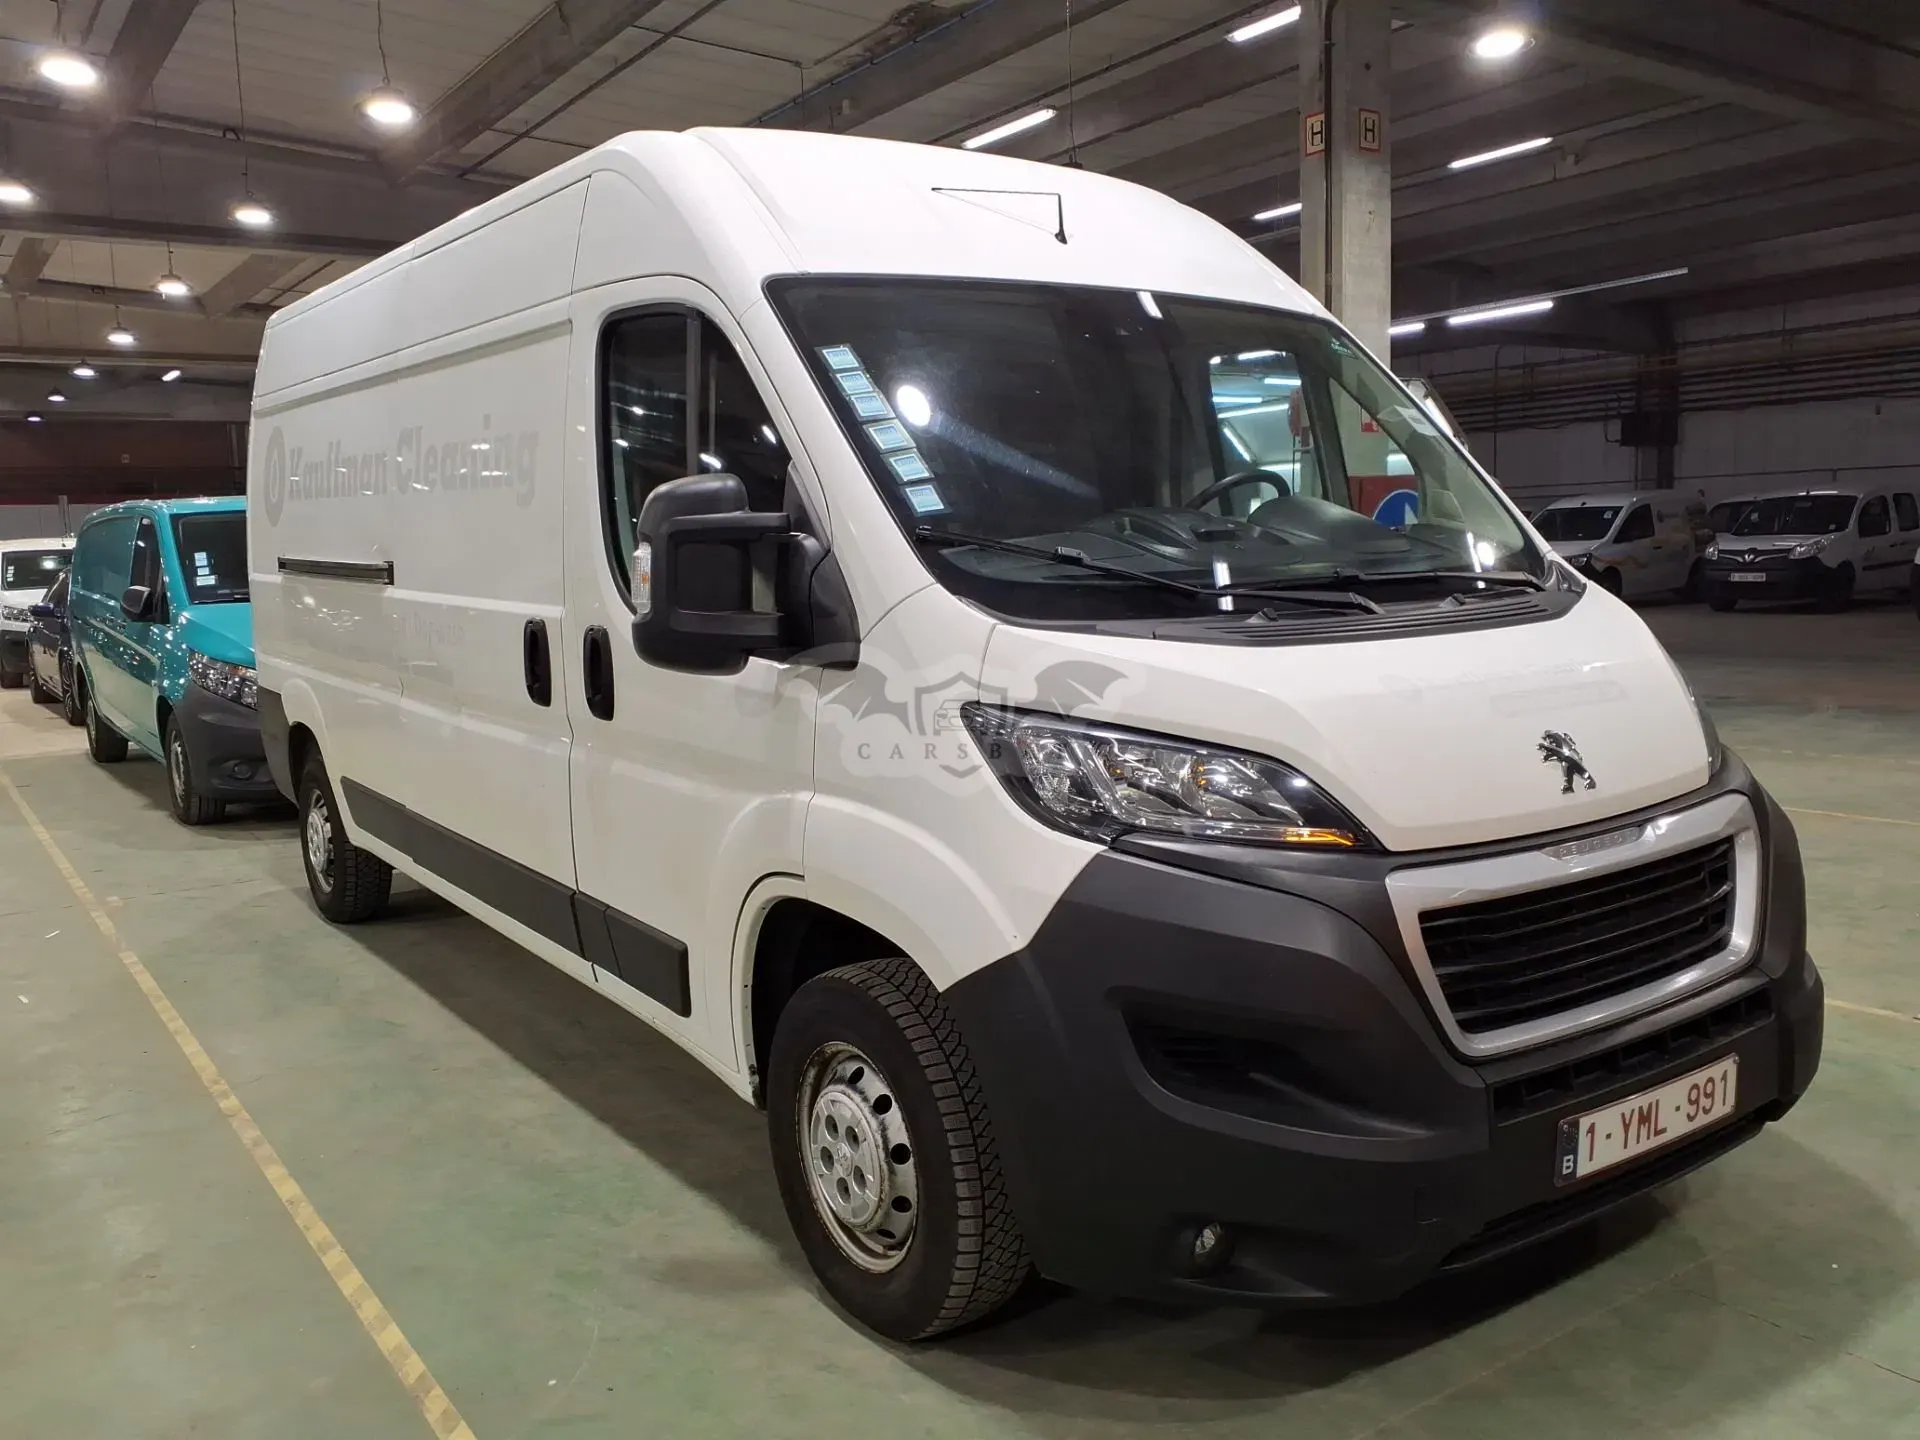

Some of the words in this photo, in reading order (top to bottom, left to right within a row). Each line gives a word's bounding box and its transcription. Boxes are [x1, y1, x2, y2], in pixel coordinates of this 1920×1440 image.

[1311, 120, 1324, 146] H
[1364, 117, 1376, 143] H
[396, 413, 539, 509] Cleaning
[1562, 1154, 1574, 1175] B
